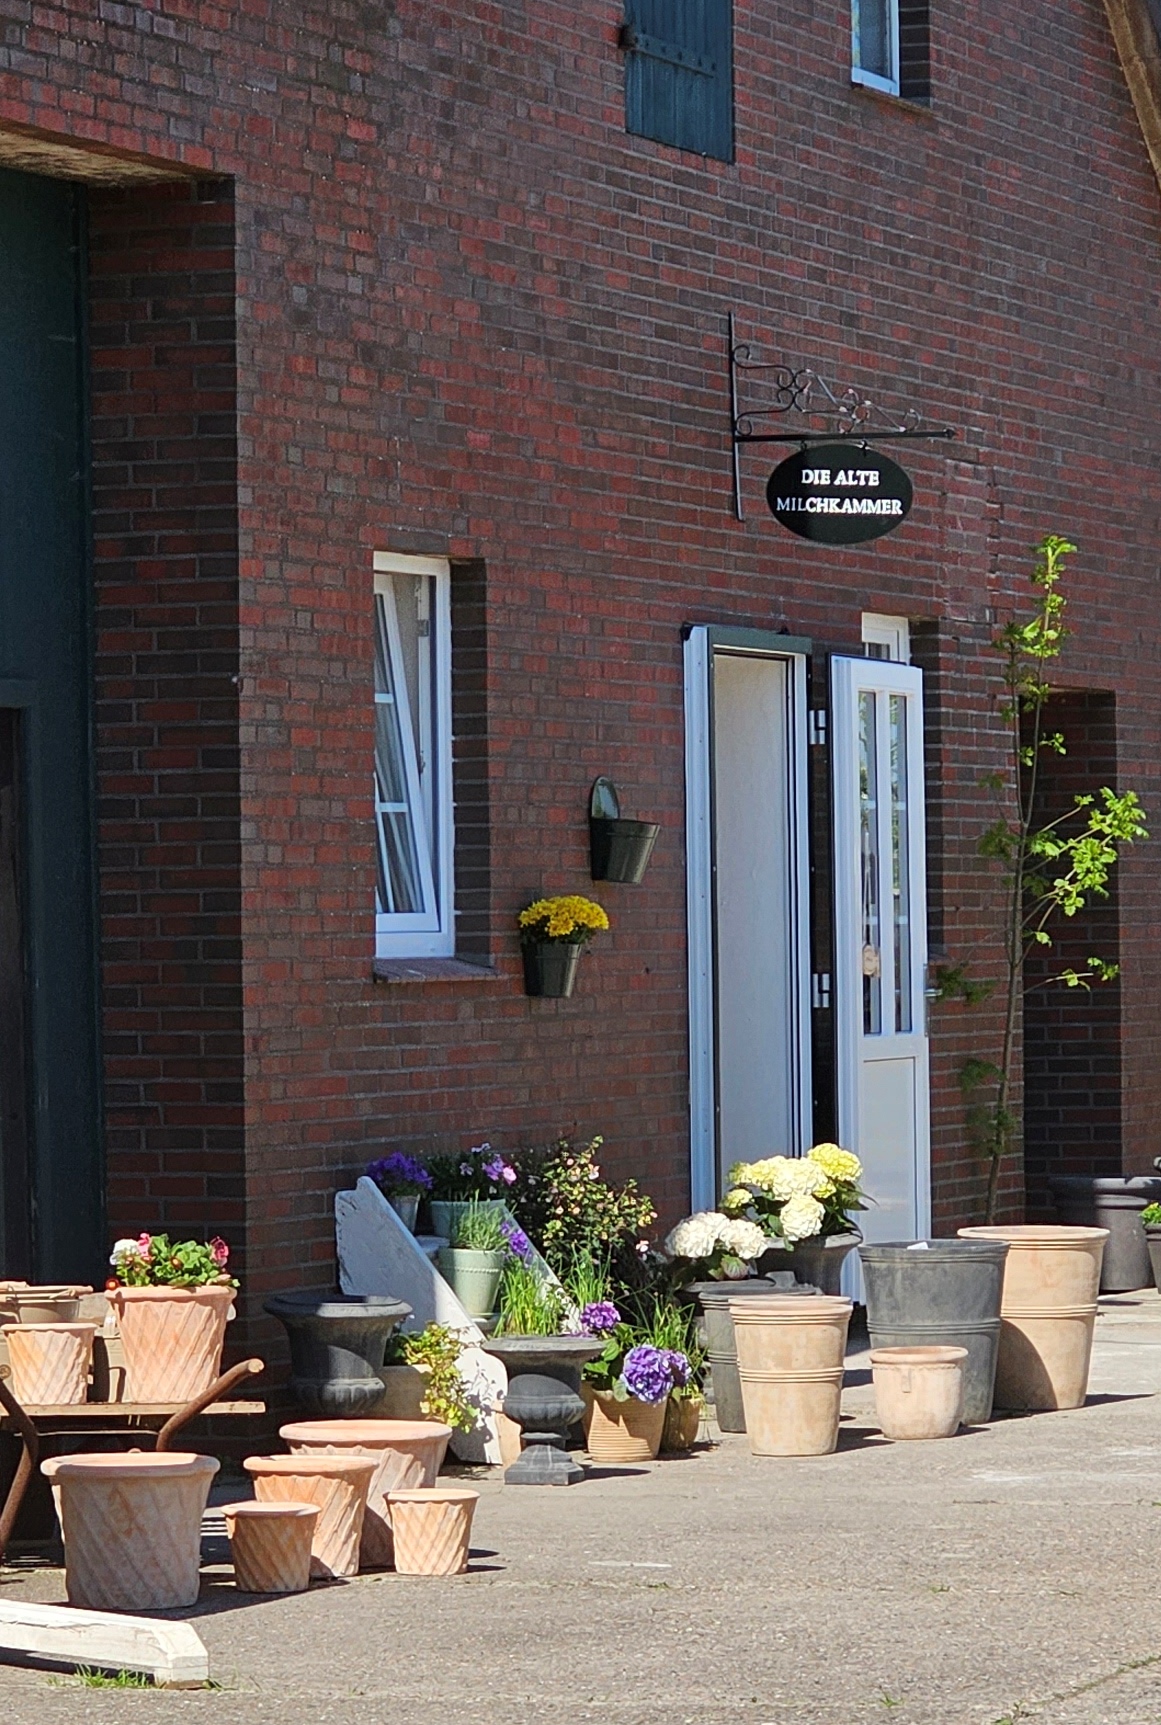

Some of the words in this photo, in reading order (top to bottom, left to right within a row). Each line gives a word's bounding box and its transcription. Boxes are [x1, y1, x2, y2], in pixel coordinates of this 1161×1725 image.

[801, 469, 831, 485] DIE
[833, 470, 880, 486] ALTE
[776, 496, 903, 515] MILCHKAMMER
